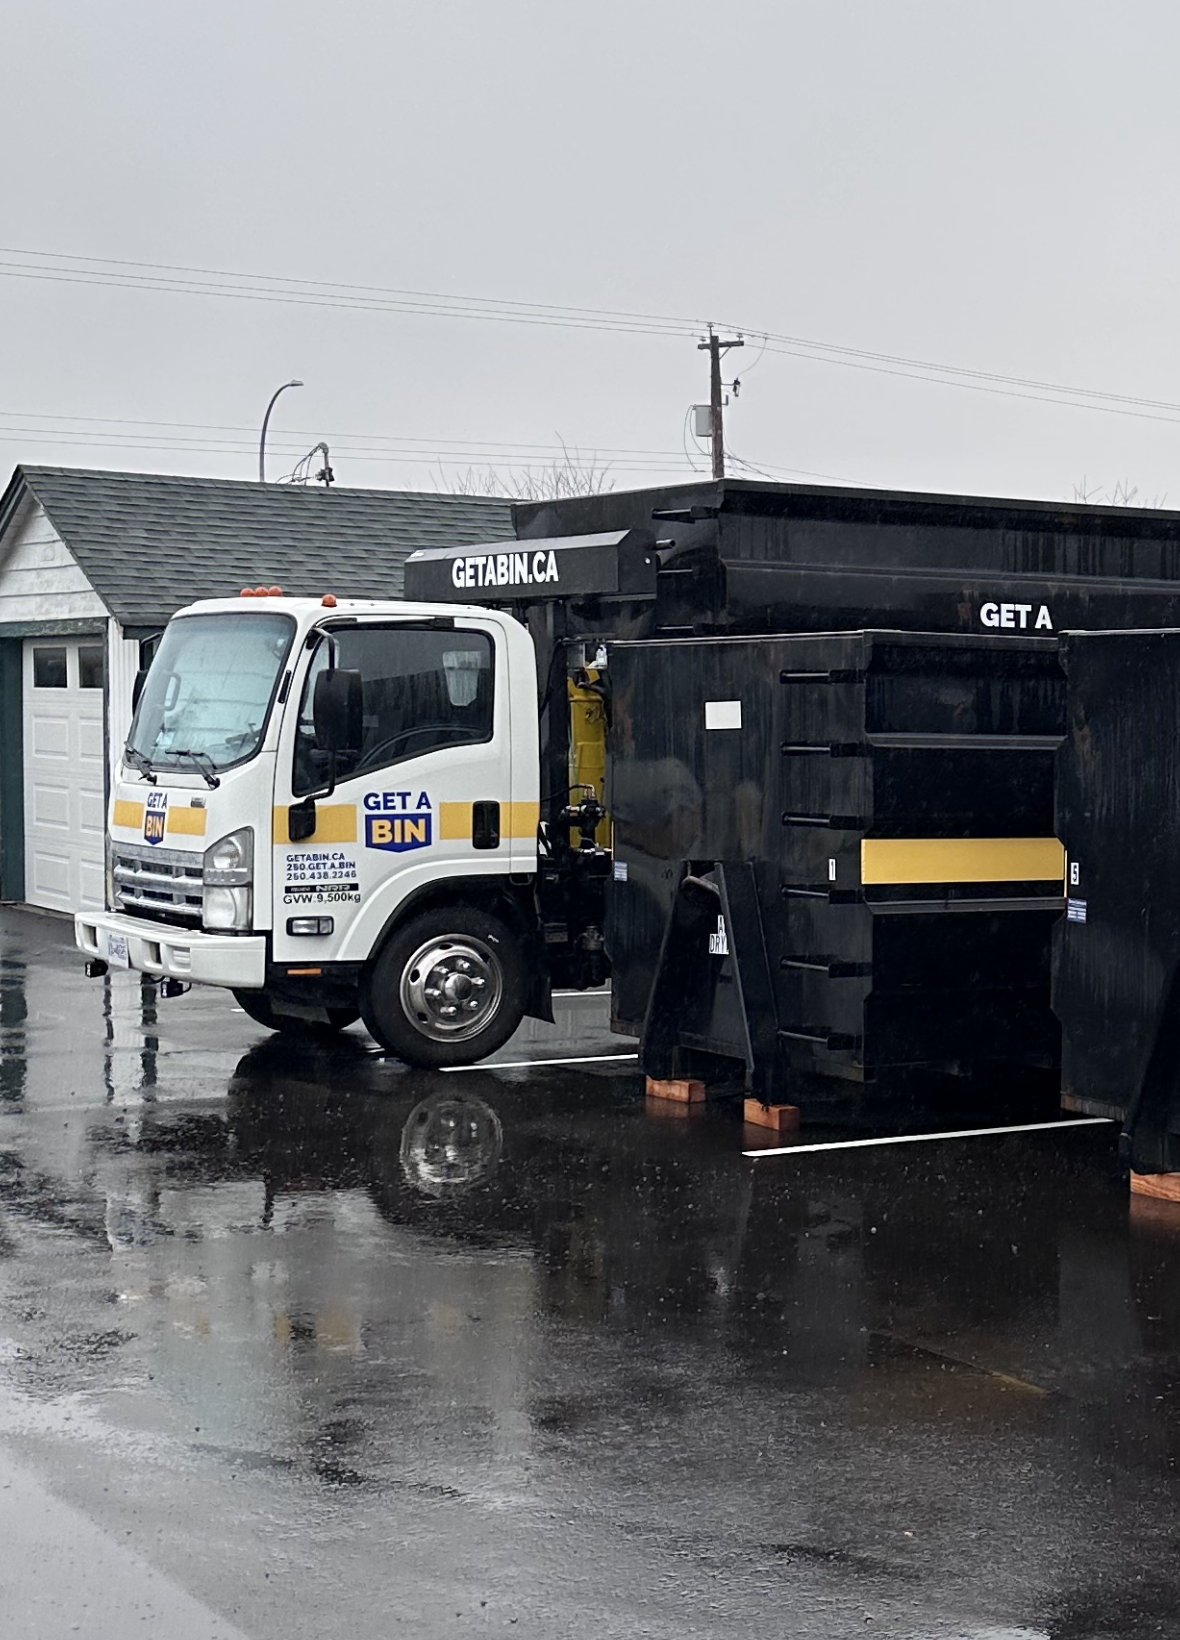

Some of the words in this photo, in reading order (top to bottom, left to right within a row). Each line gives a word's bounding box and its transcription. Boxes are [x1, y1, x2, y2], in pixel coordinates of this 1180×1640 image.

[452, 550, 559, 588] GETABIN.CA
[980, 602, 1032, 628] GET
[1034, 605, 1053, 630] A
[147, 792, 163, 808] GET
[161, 792, 168, 809] A
[363, 792, 412, 811] GET
[415, 791, 432, 810] A
[145, 815, 164, 838] BIN
[371, 818, 426, 844] BIN
[286, 853, 345, 862] GETABIN.CA
[286, 861, 356, 871] 250.GET.A.BIN
[710, 934, 729, 953] DRY
